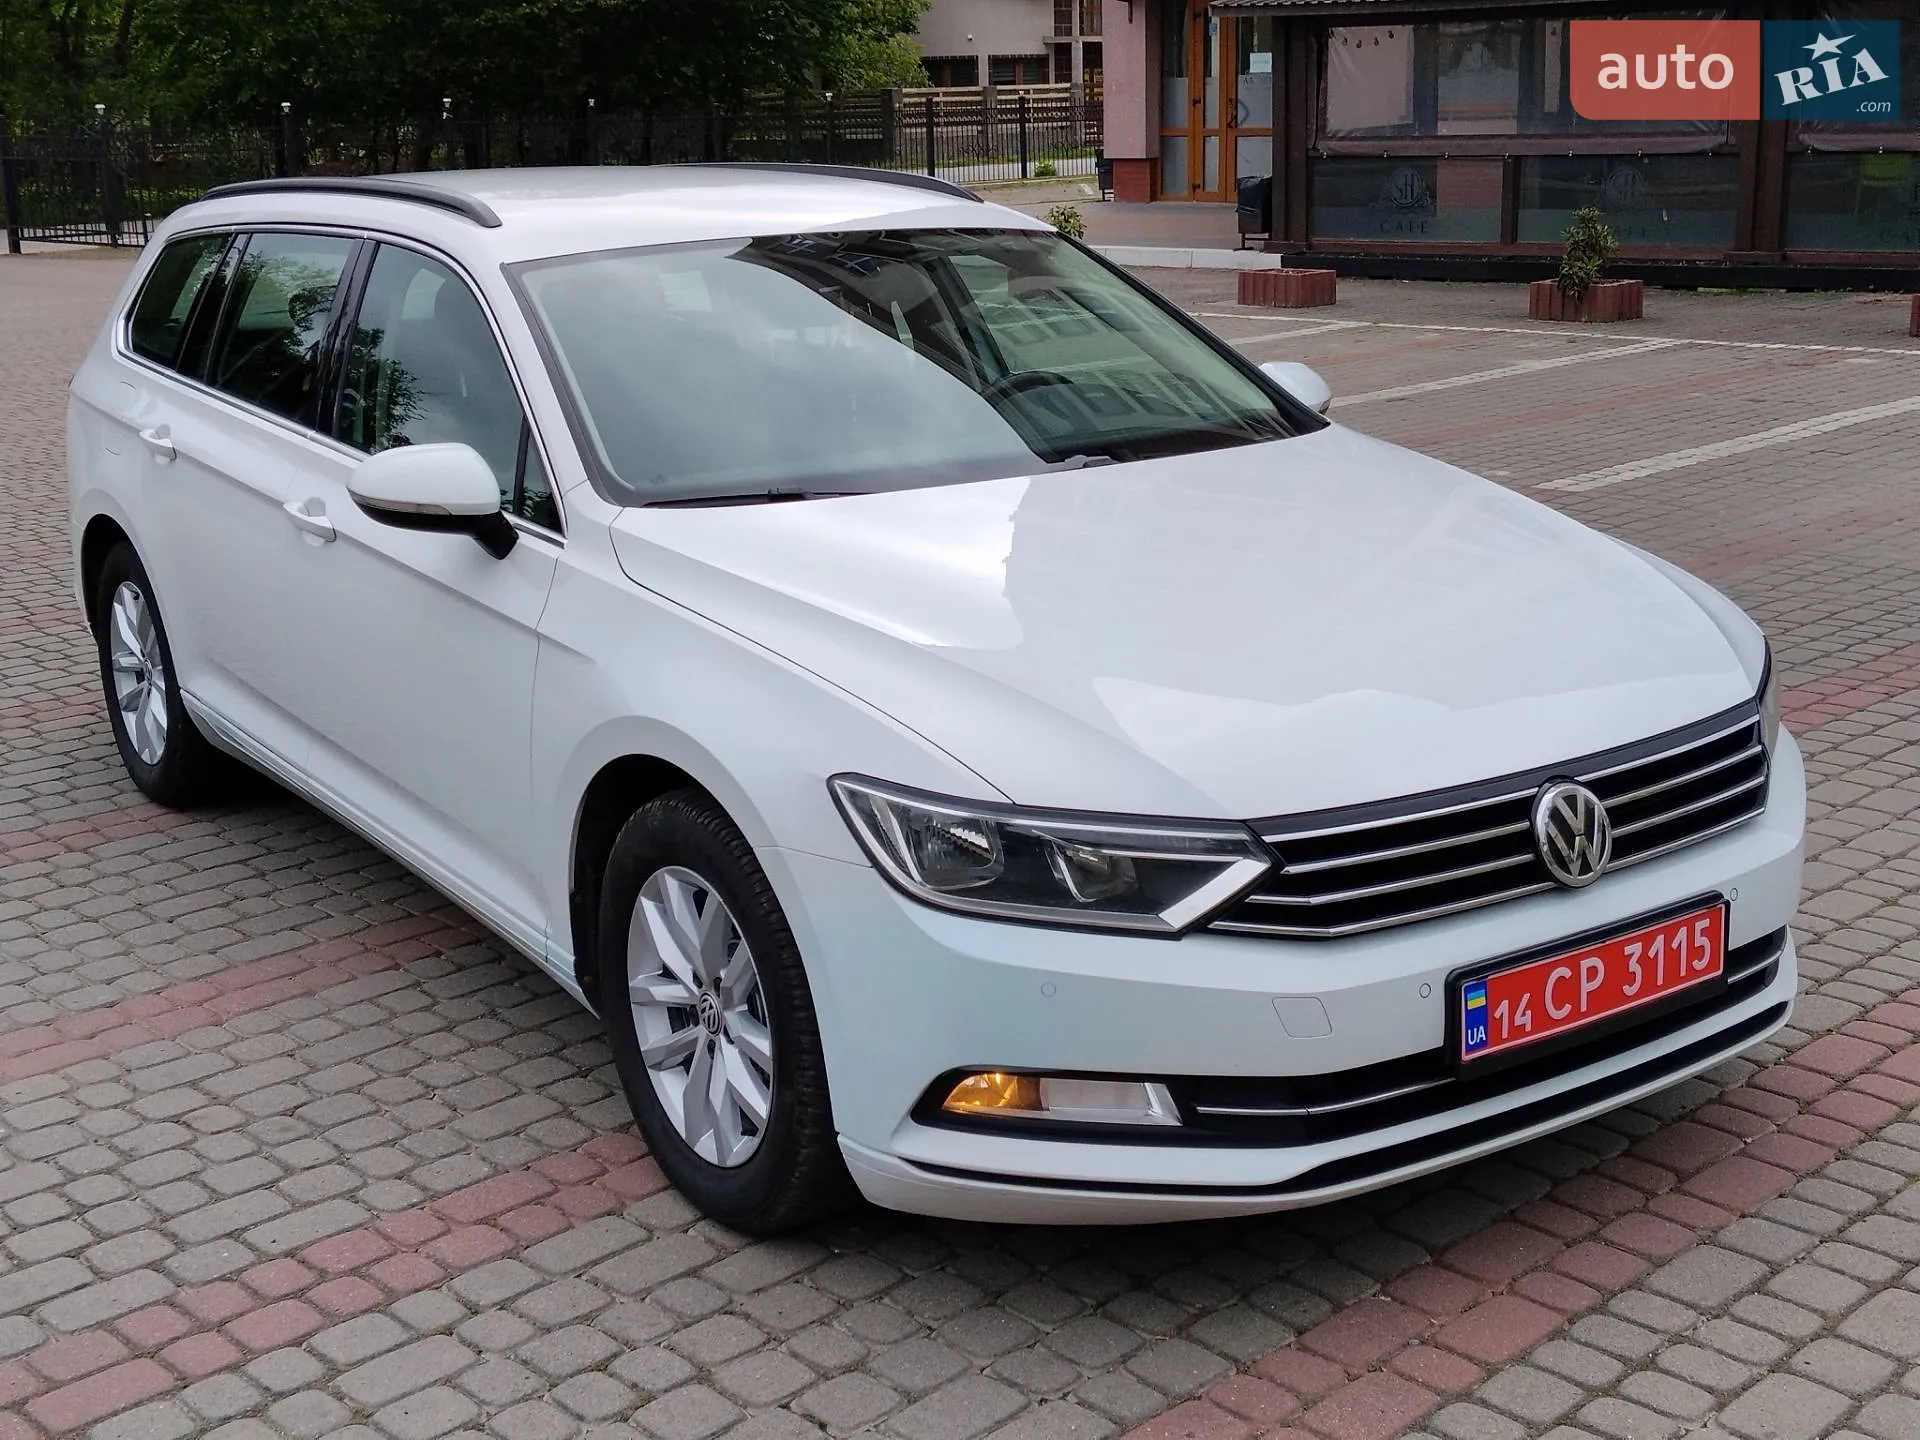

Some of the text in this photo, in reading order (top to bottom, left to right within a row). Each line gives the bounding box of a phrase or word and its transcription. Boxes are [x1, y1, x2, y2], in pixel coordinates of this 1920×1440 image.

[1380, 220, 1429, 234] CAFE
[1494, 918, 1712, 1039] 14 CP 3115
[1467, 1025, 1486, 1046] UA
